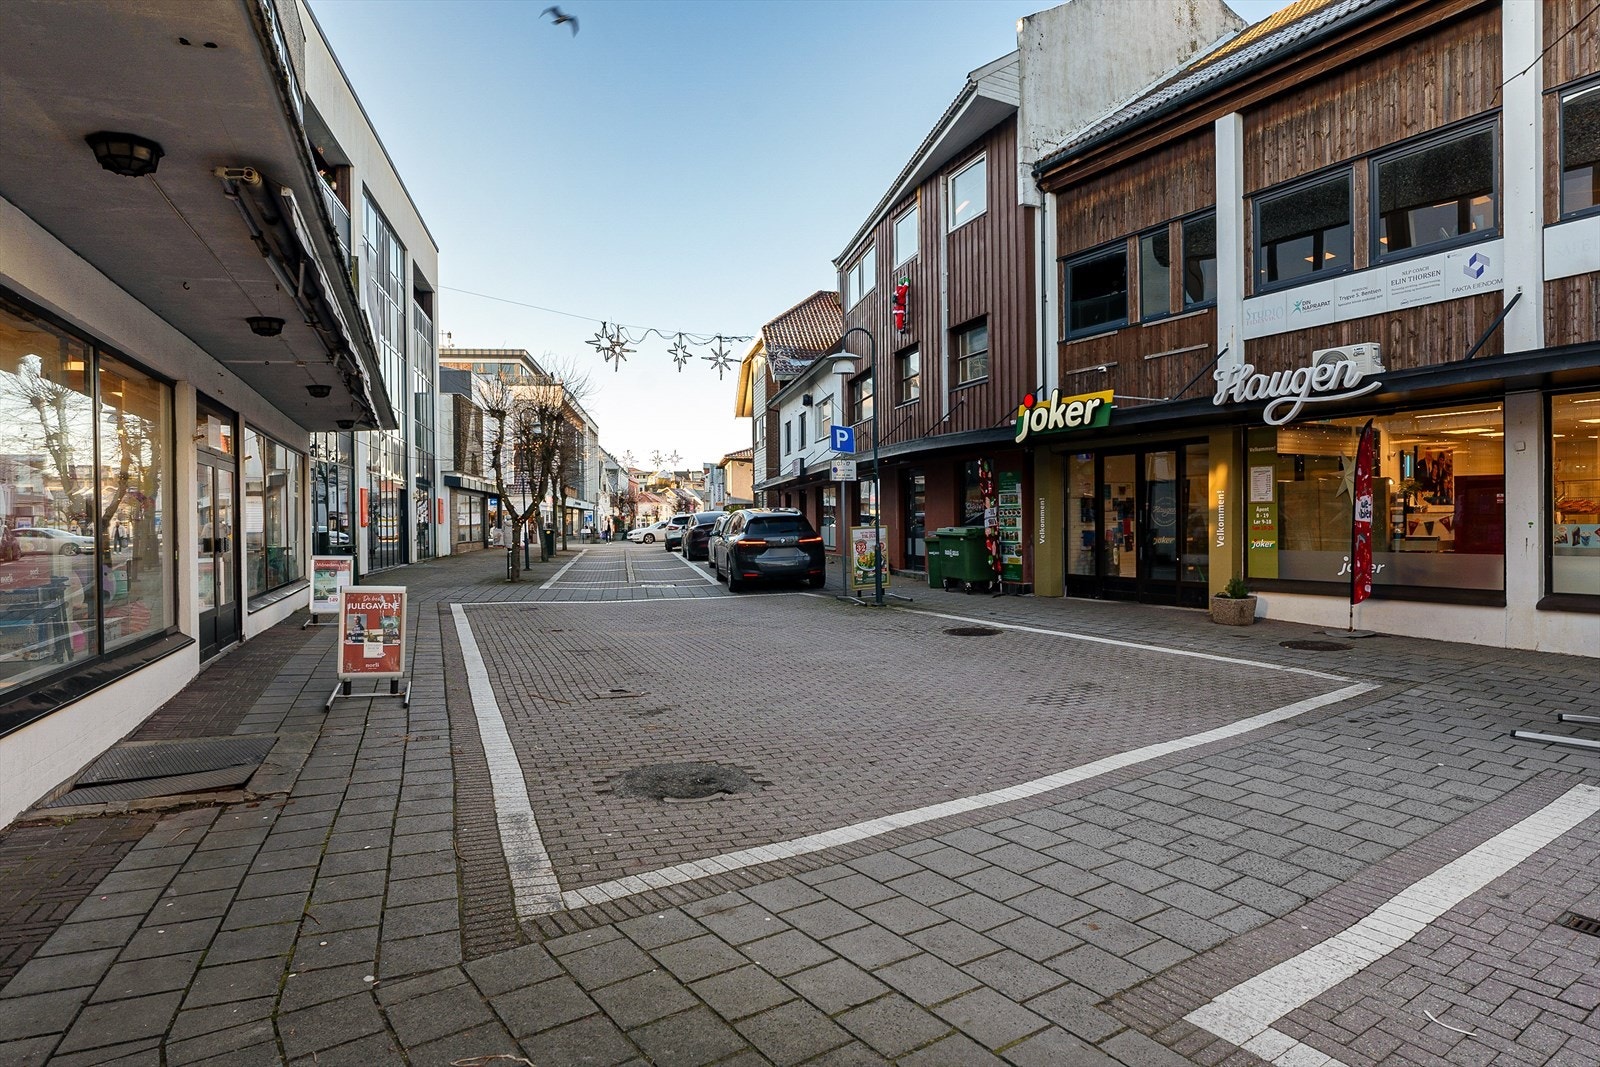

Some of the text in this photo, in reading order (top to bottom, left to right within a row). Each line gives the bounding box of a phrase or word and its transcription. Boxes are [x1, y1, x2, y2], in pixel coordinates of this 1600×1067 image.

[1390, 270, 1441, 287] ELIN THORSEN
[1452, 285, 1472, 293] FAKTA
[1302, 300, 1331, 312] NAPRAPAT
[1213, 360, 1383, 426] Haugen
[1015, 388, 1100, 443] joker
[836, 429, 849, 449] P
[1216, 489, 1225, 547] Velkommen!
[1251, 538, 1273, 549] joker
[1337, 556, 1385, 576] jer
[347, 602, 400, 610] JULEGAVENE
